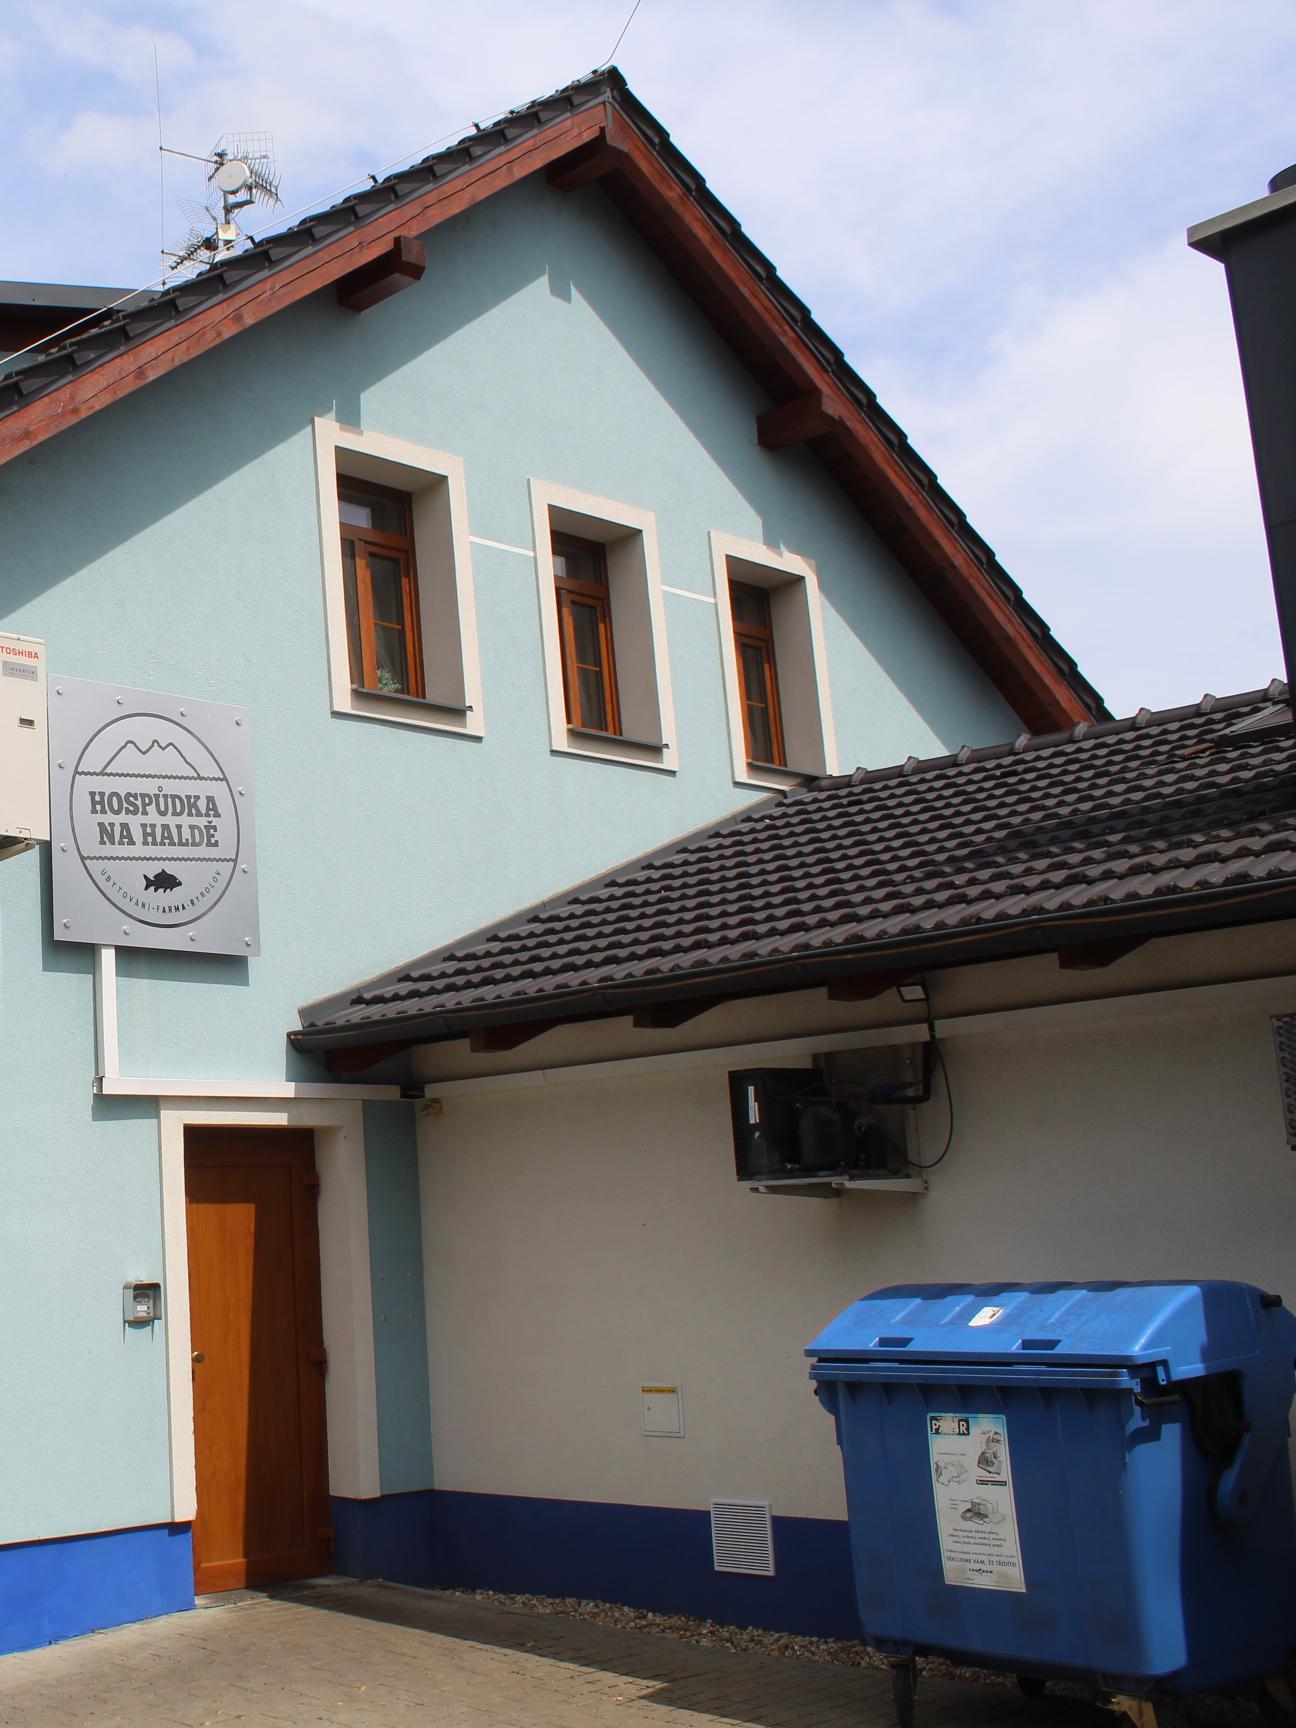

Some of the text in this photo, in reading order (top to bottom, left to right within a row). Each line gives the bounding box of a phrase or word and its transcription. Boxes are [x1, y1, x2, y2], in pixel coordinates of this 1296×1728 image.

[0, 645, 39, 660] TOSHIBA
[88, 786, 221, 818] HOSPŮDKA
[97, 820, 219, 847] NA HALDĚ
